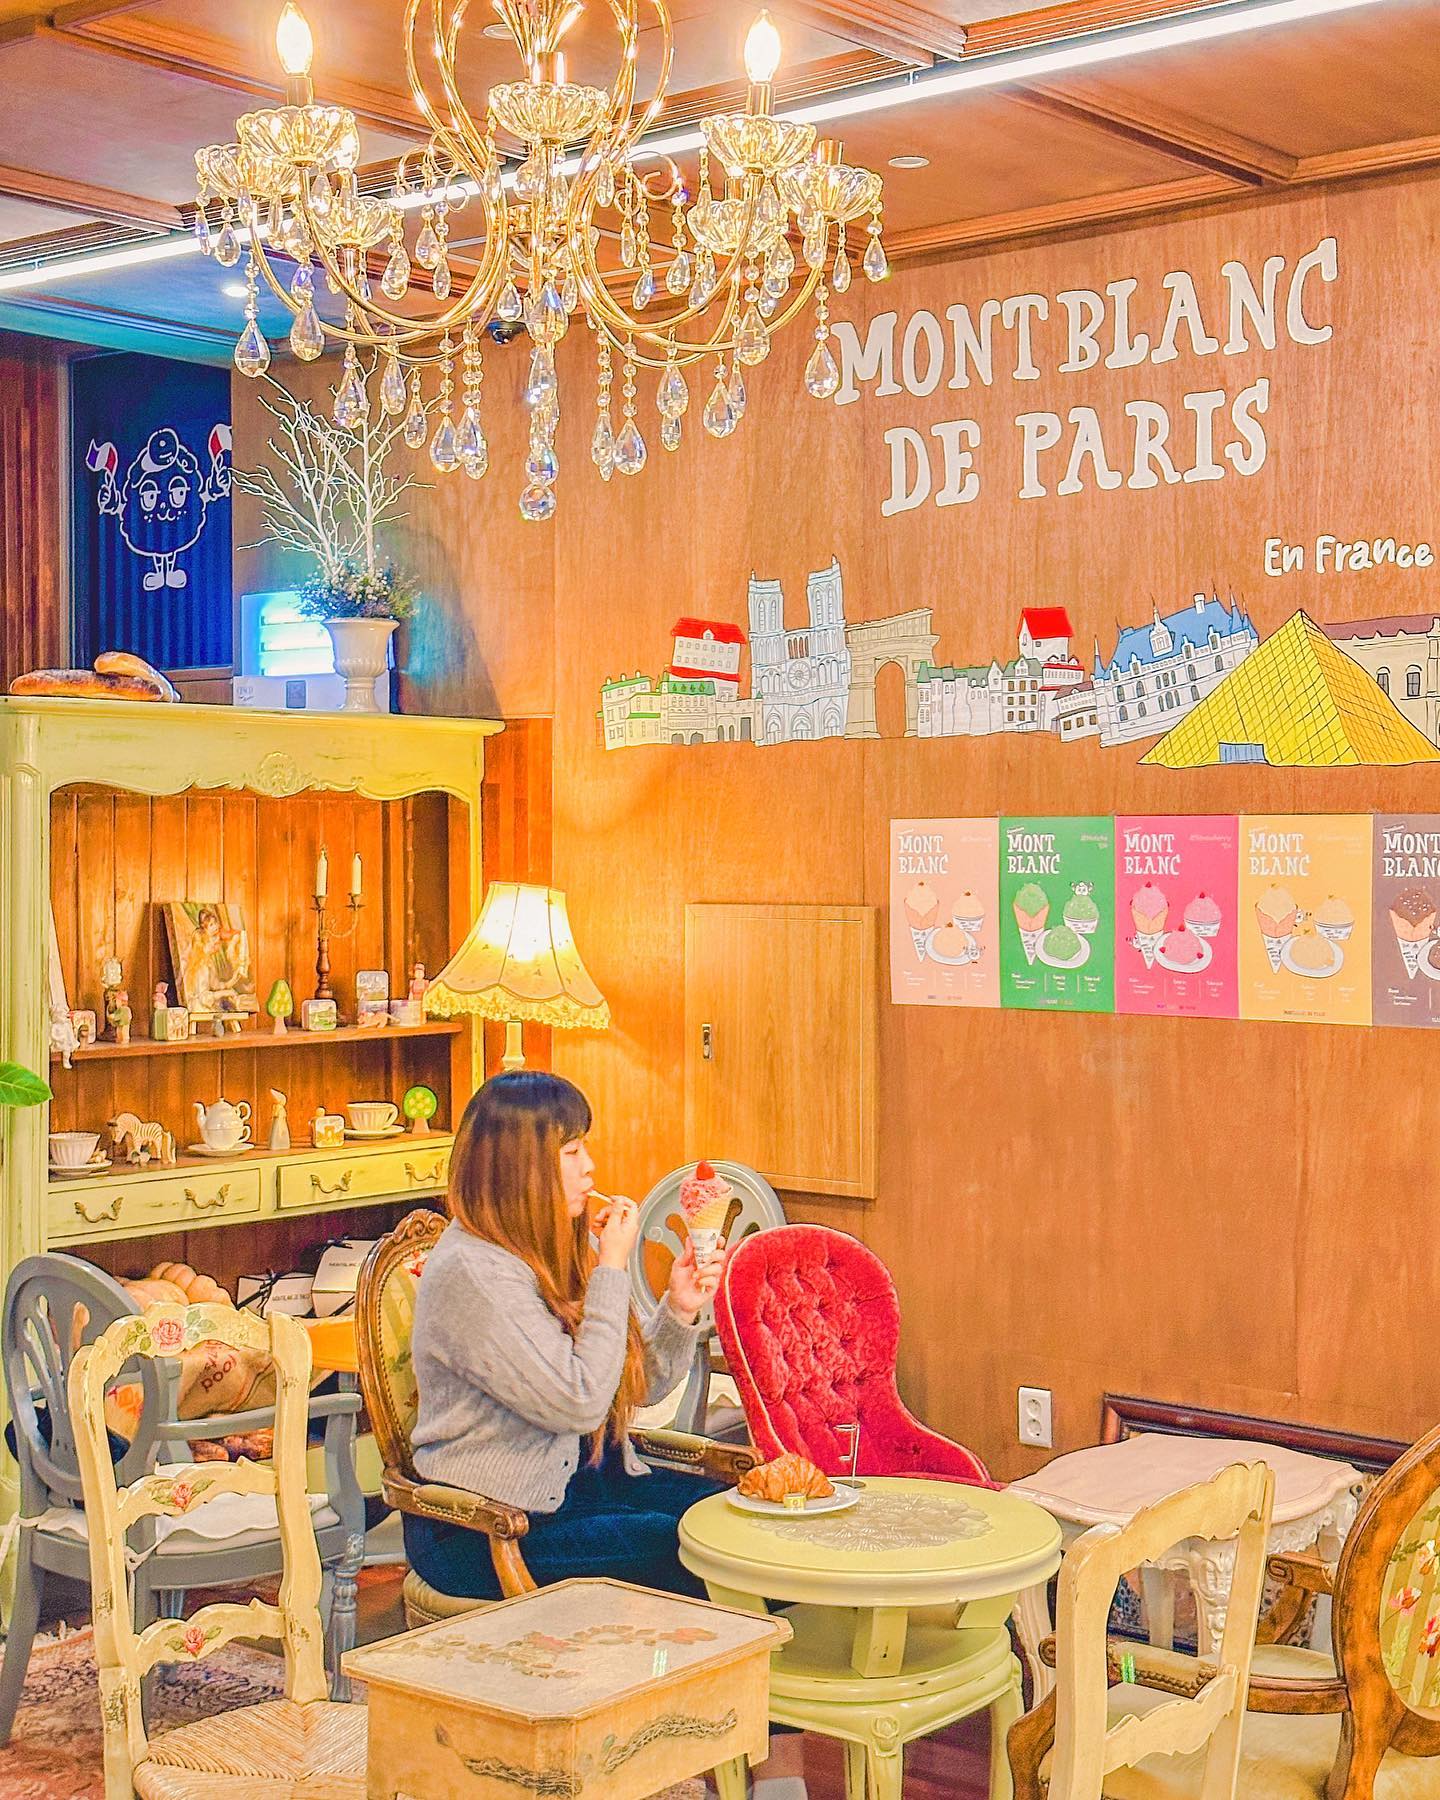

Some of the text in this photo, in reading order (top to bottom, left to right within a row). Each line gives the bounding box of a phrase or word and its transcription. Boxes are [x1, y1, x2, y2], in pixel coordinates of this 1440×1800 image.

[881, 377, 1270, 517] DE PARIS
[1264, 534, 1435, 577] En France
[898, 834, 944, 854] MONT
[1007, 833, 1055, 853] MONT
[1123, 833, 1175, 853] MONT
[1248, 832, 1304, 853] MONT
[1382, 832, 1440, 854] MONT
[898, 854, 949, 875] BLANC
[1007, 853, 1060, 875] BLANC
[1124, 854, 1181, 876] BLANC
[1248, 854, 1311, 877] BLANC
[1382, 856, 1440, 878] BLAN
